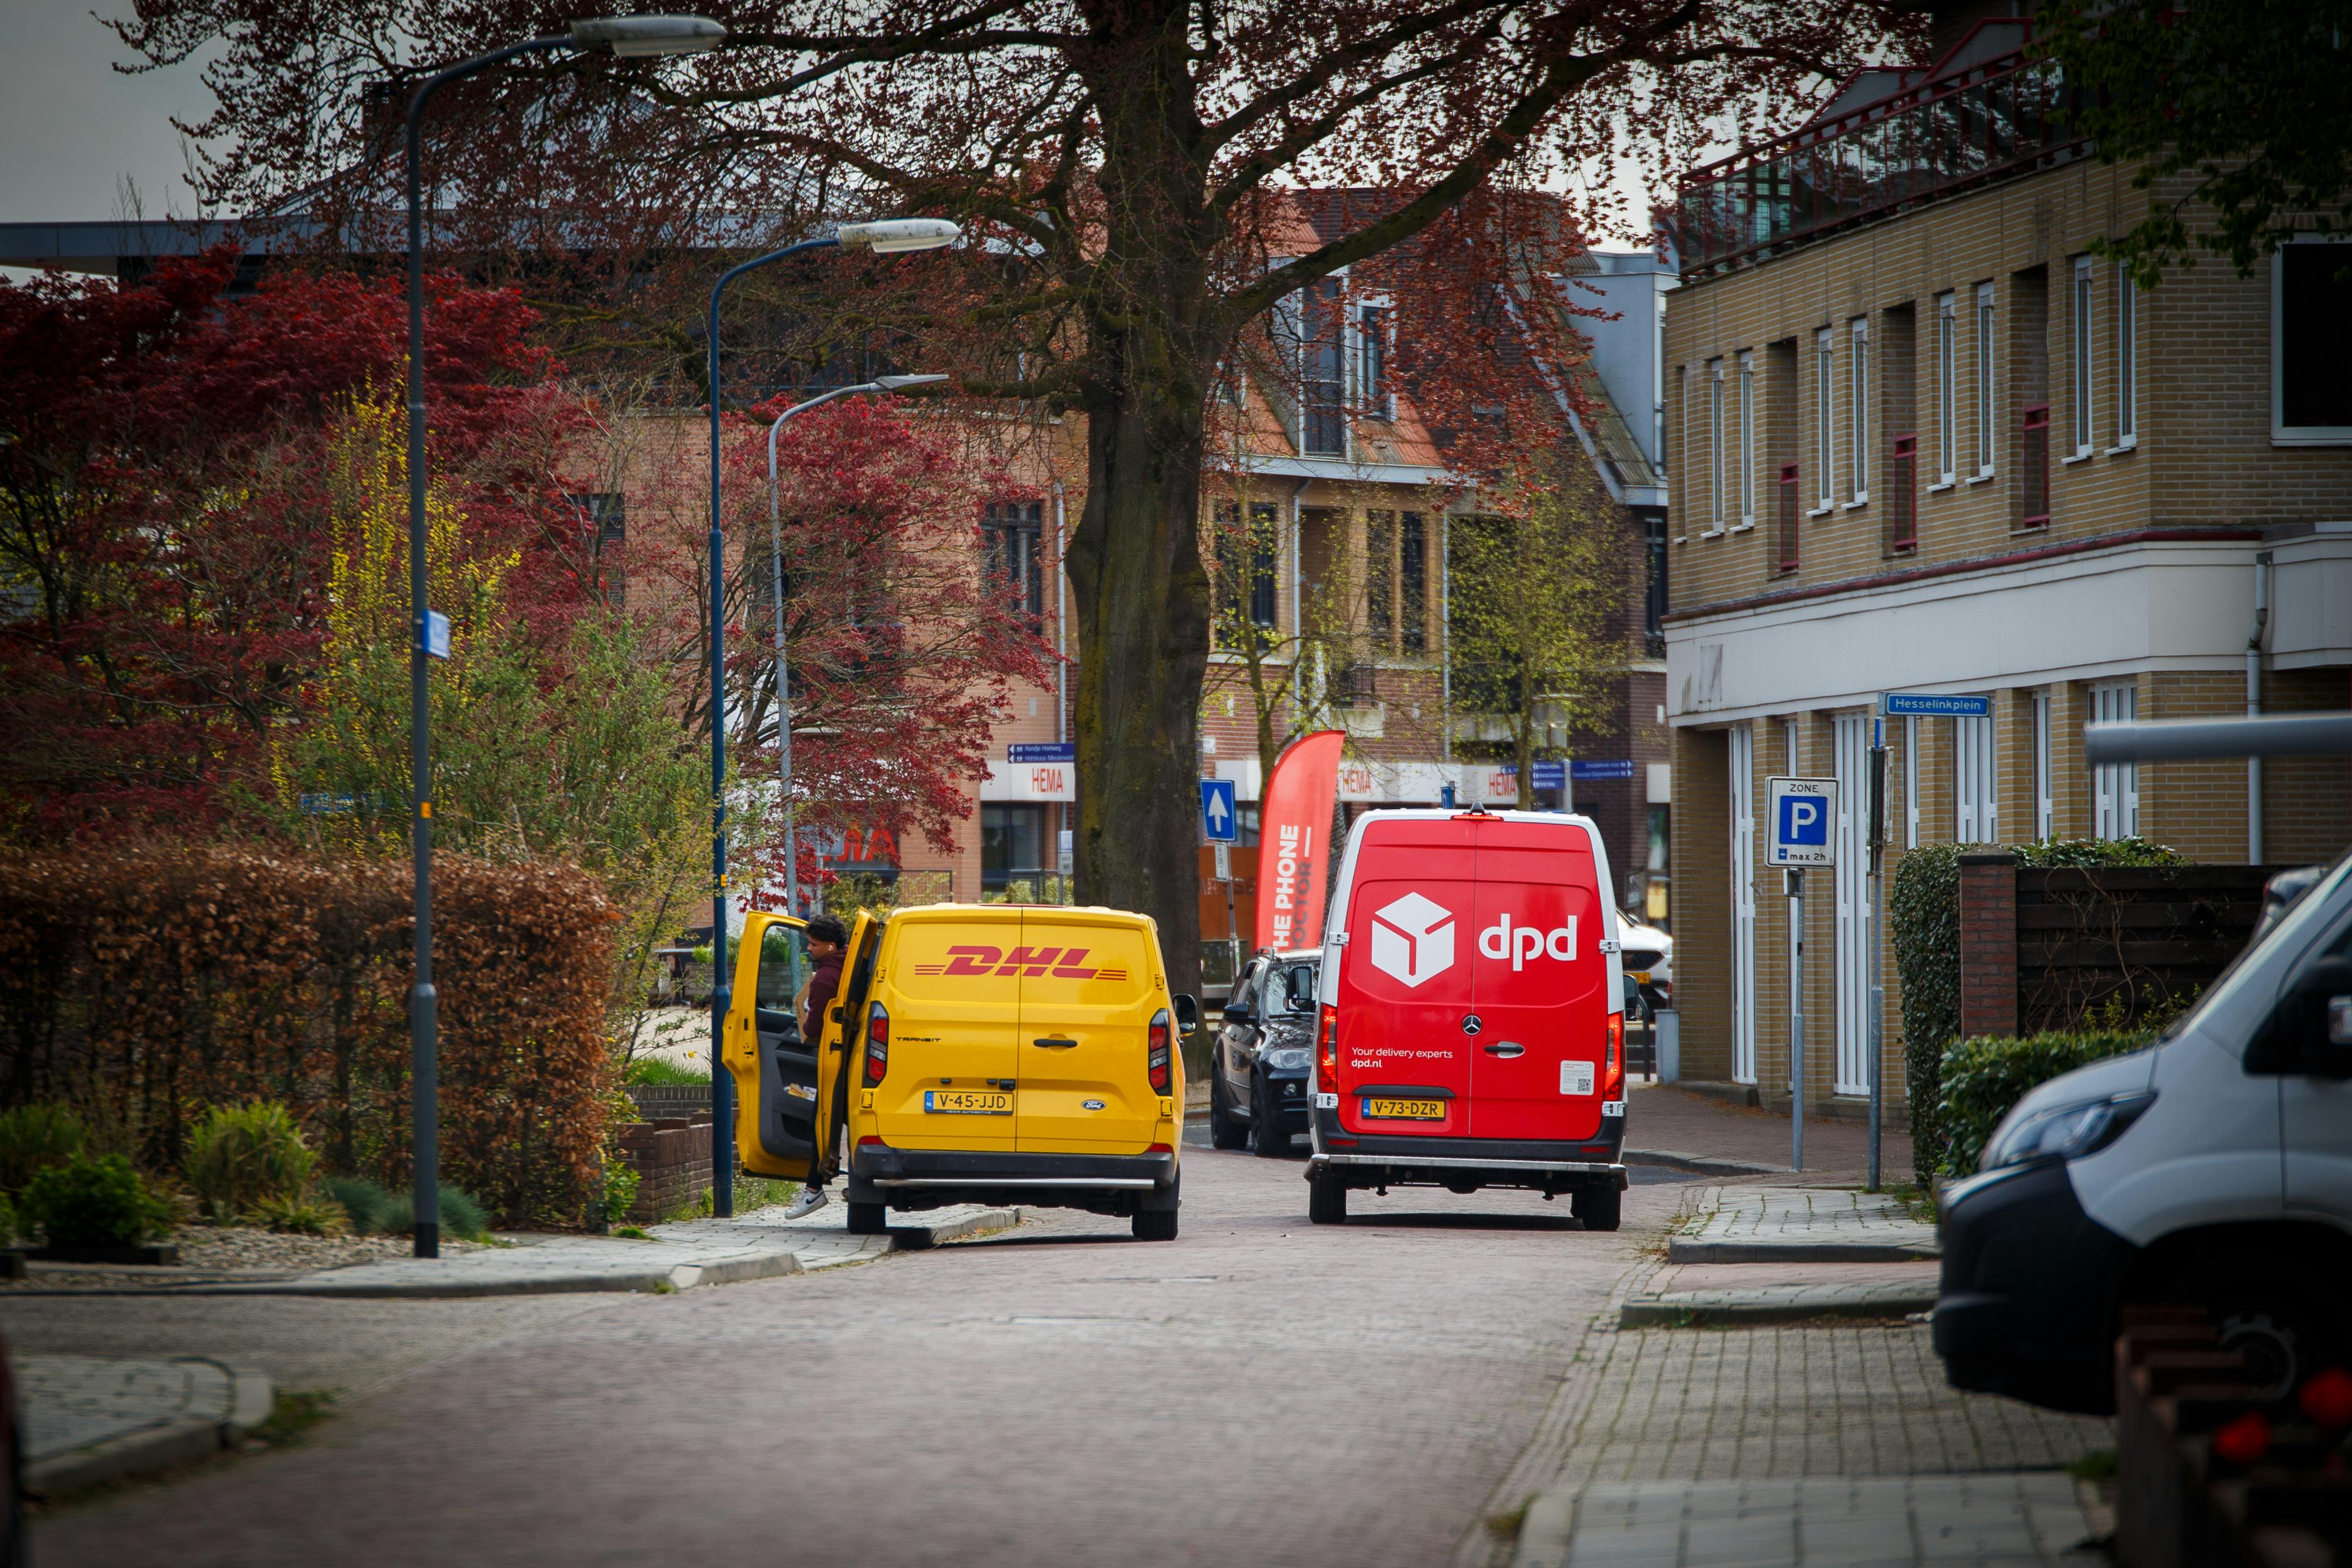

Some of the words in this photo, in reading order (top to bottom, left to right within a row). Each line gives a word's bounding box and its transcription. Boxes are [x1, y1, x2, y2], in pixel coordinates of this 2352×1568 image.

[1895, 698, 1980, 711] Hesselinkplein
[1032, 768, 1064, 793] HEMA
[1342, 769, 1372, 793] HEMA
[1488, 773, 1516, 797] HEMA
[1789, 783, 1819, 793] ZONE
[1791, 802, 1817, 839] P
[1275, 825, 1299, 909] PHONE
[1813, 853, 1826, 861] 2h
[1273, 915, 1291, 953] HE
[1478, 913, 1577, 971] dpd
[943, 946, 1099, 979] DHL
[1351, 1059, 1383, 1068] dpd.nl
[1352, 1047, 1374, 1056] Your
[1376, 1048, 1415, 1059] delivery
[1416, 1050, 1454, 1059] experts
[939, 1094, 1006, 1108] V-45-JJD
[1375, 1101, 1438, 1115] V-73-DZR
